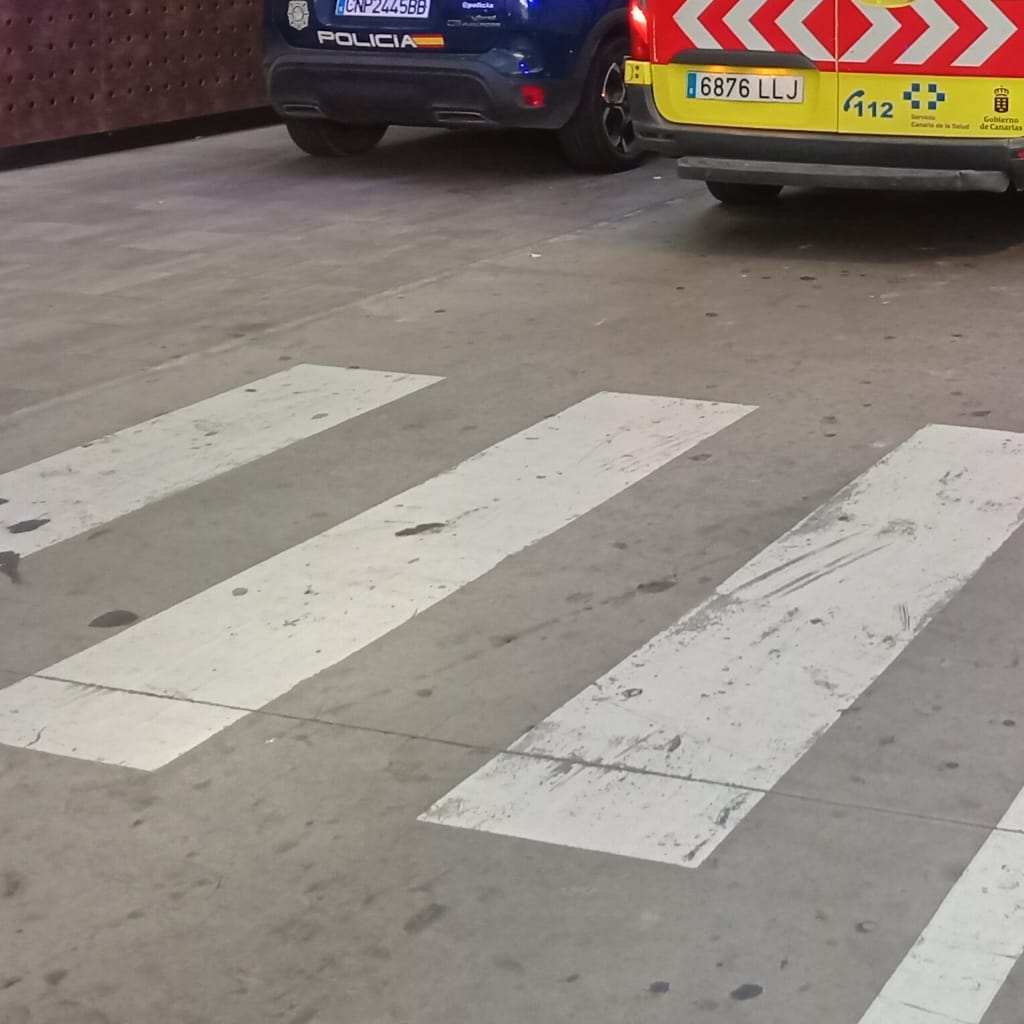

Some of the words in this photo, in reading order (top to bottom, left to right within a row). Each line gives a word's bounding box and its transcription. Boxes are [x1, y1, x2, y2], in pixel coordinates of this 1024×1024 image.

[317, 30, 417, 48] POLICIA
[701, 76, 750, 98] 6876
[759, 78, 798, 100] LLJ
[854, 101, 893, 118] 112
[983, 115, 1019, 124] Gobierno
[989, 123, 1023, 132] Canarias
